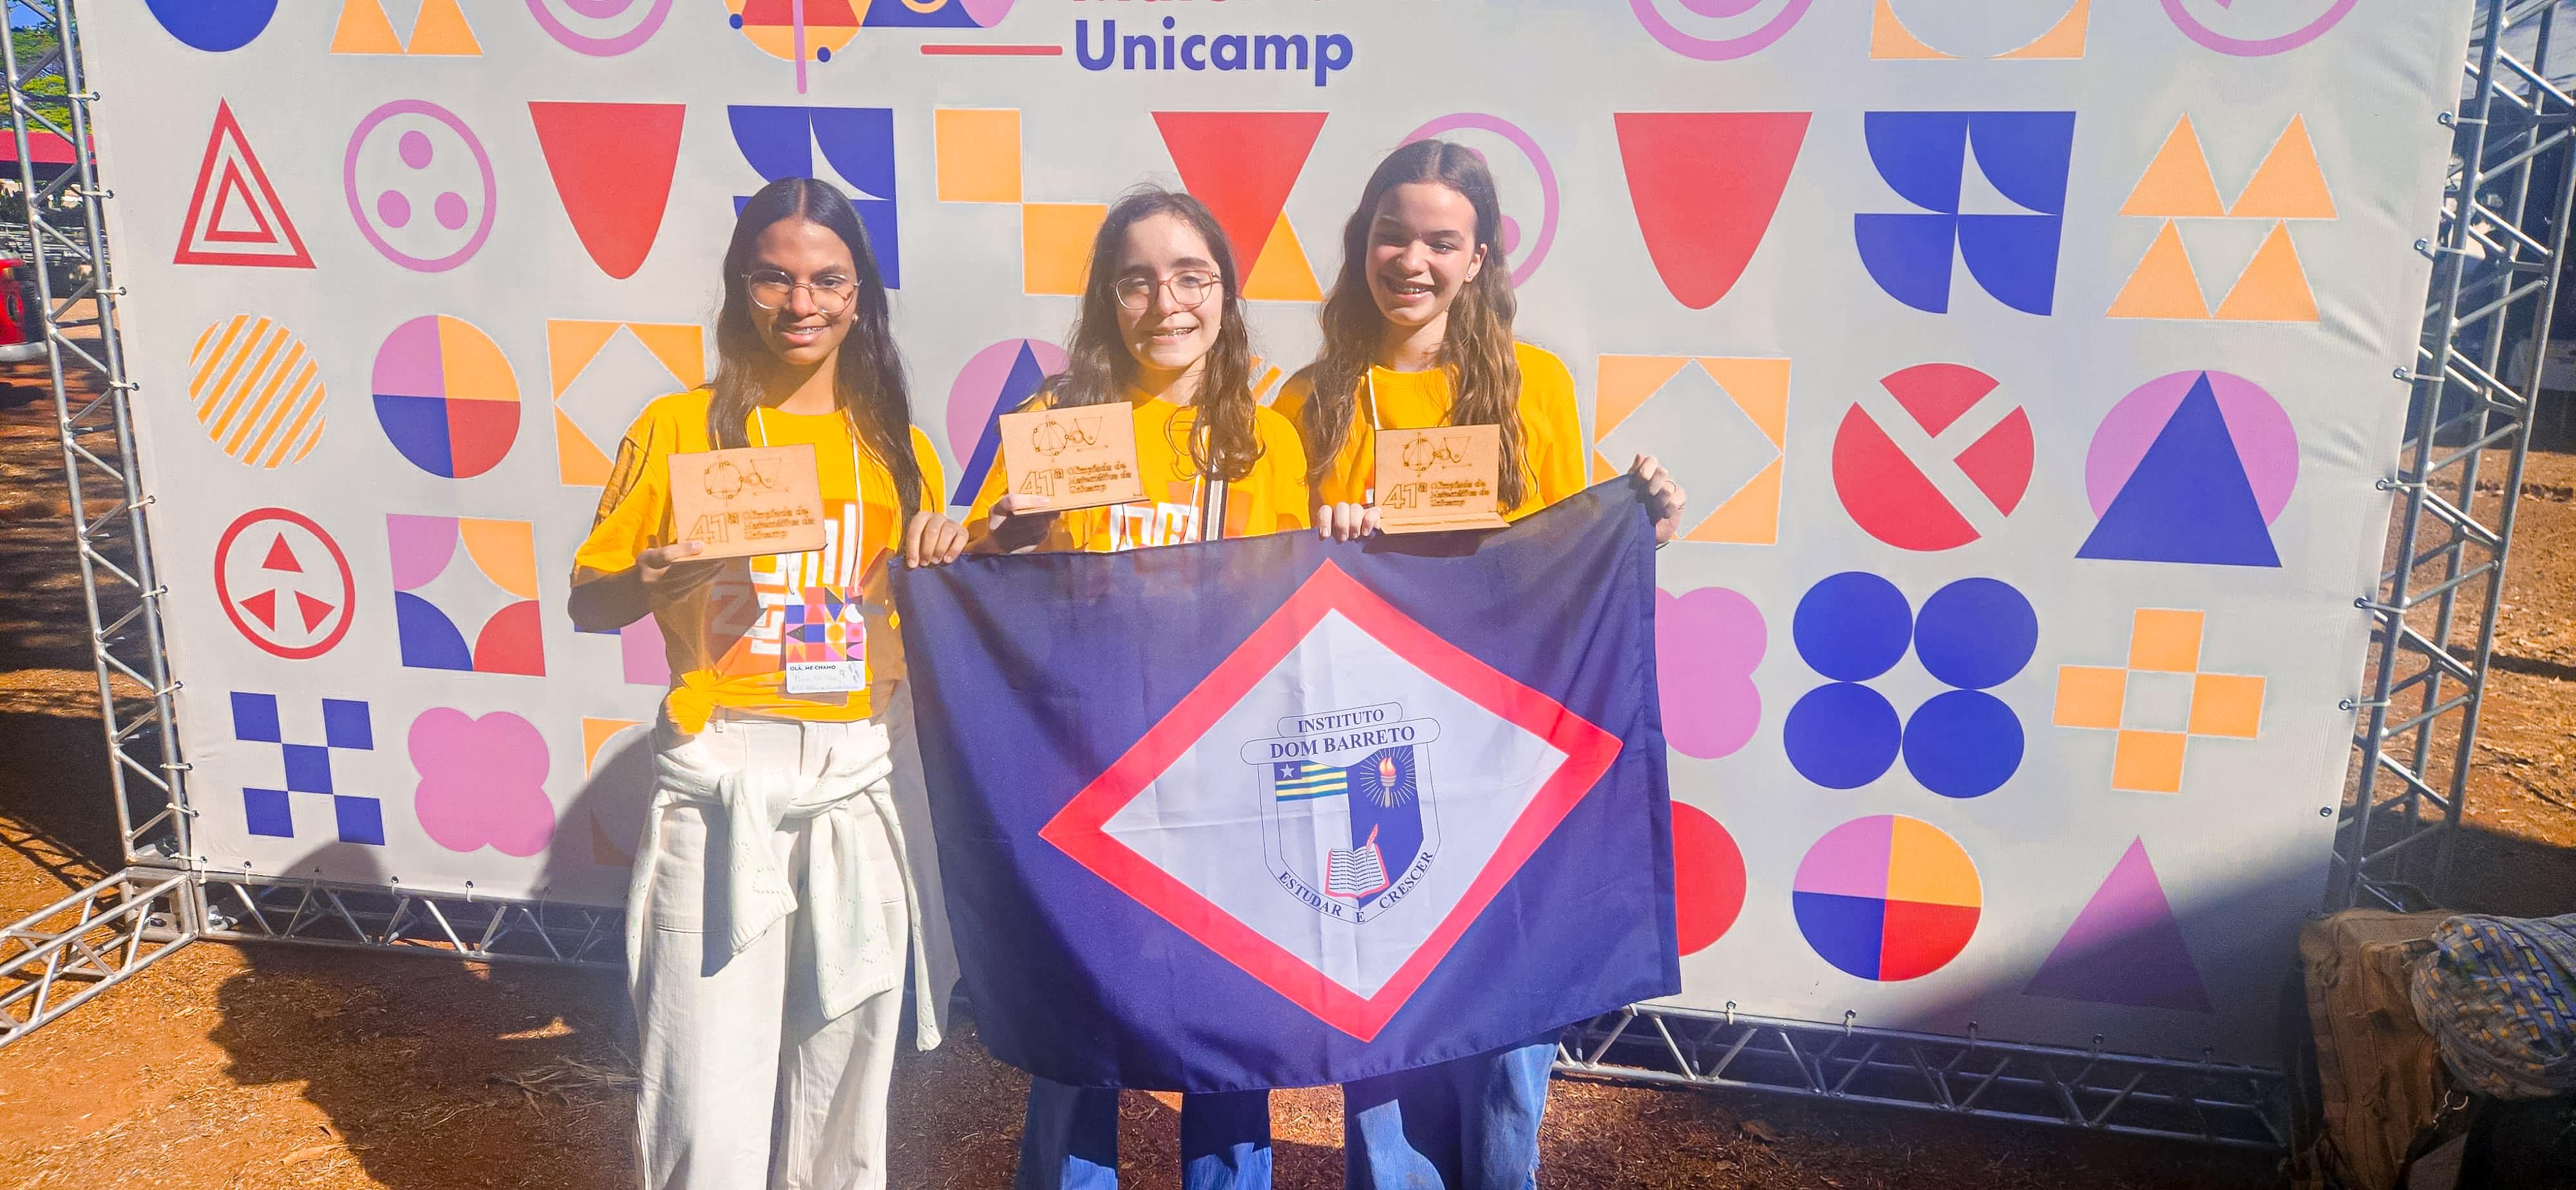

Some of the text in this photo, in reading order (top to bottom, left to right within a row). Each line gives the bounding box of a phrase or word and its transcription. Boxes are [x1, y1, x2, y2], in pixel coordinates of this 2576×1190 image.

[1075, 15, 1354, 87] Unicamp
[1269, 726, 1416, 759] DOM BARRETO
[1298, 708, 1384, 733] INSTITUTO
[1278, 851, 1434, 923] ESTUDAR E CRESCER
